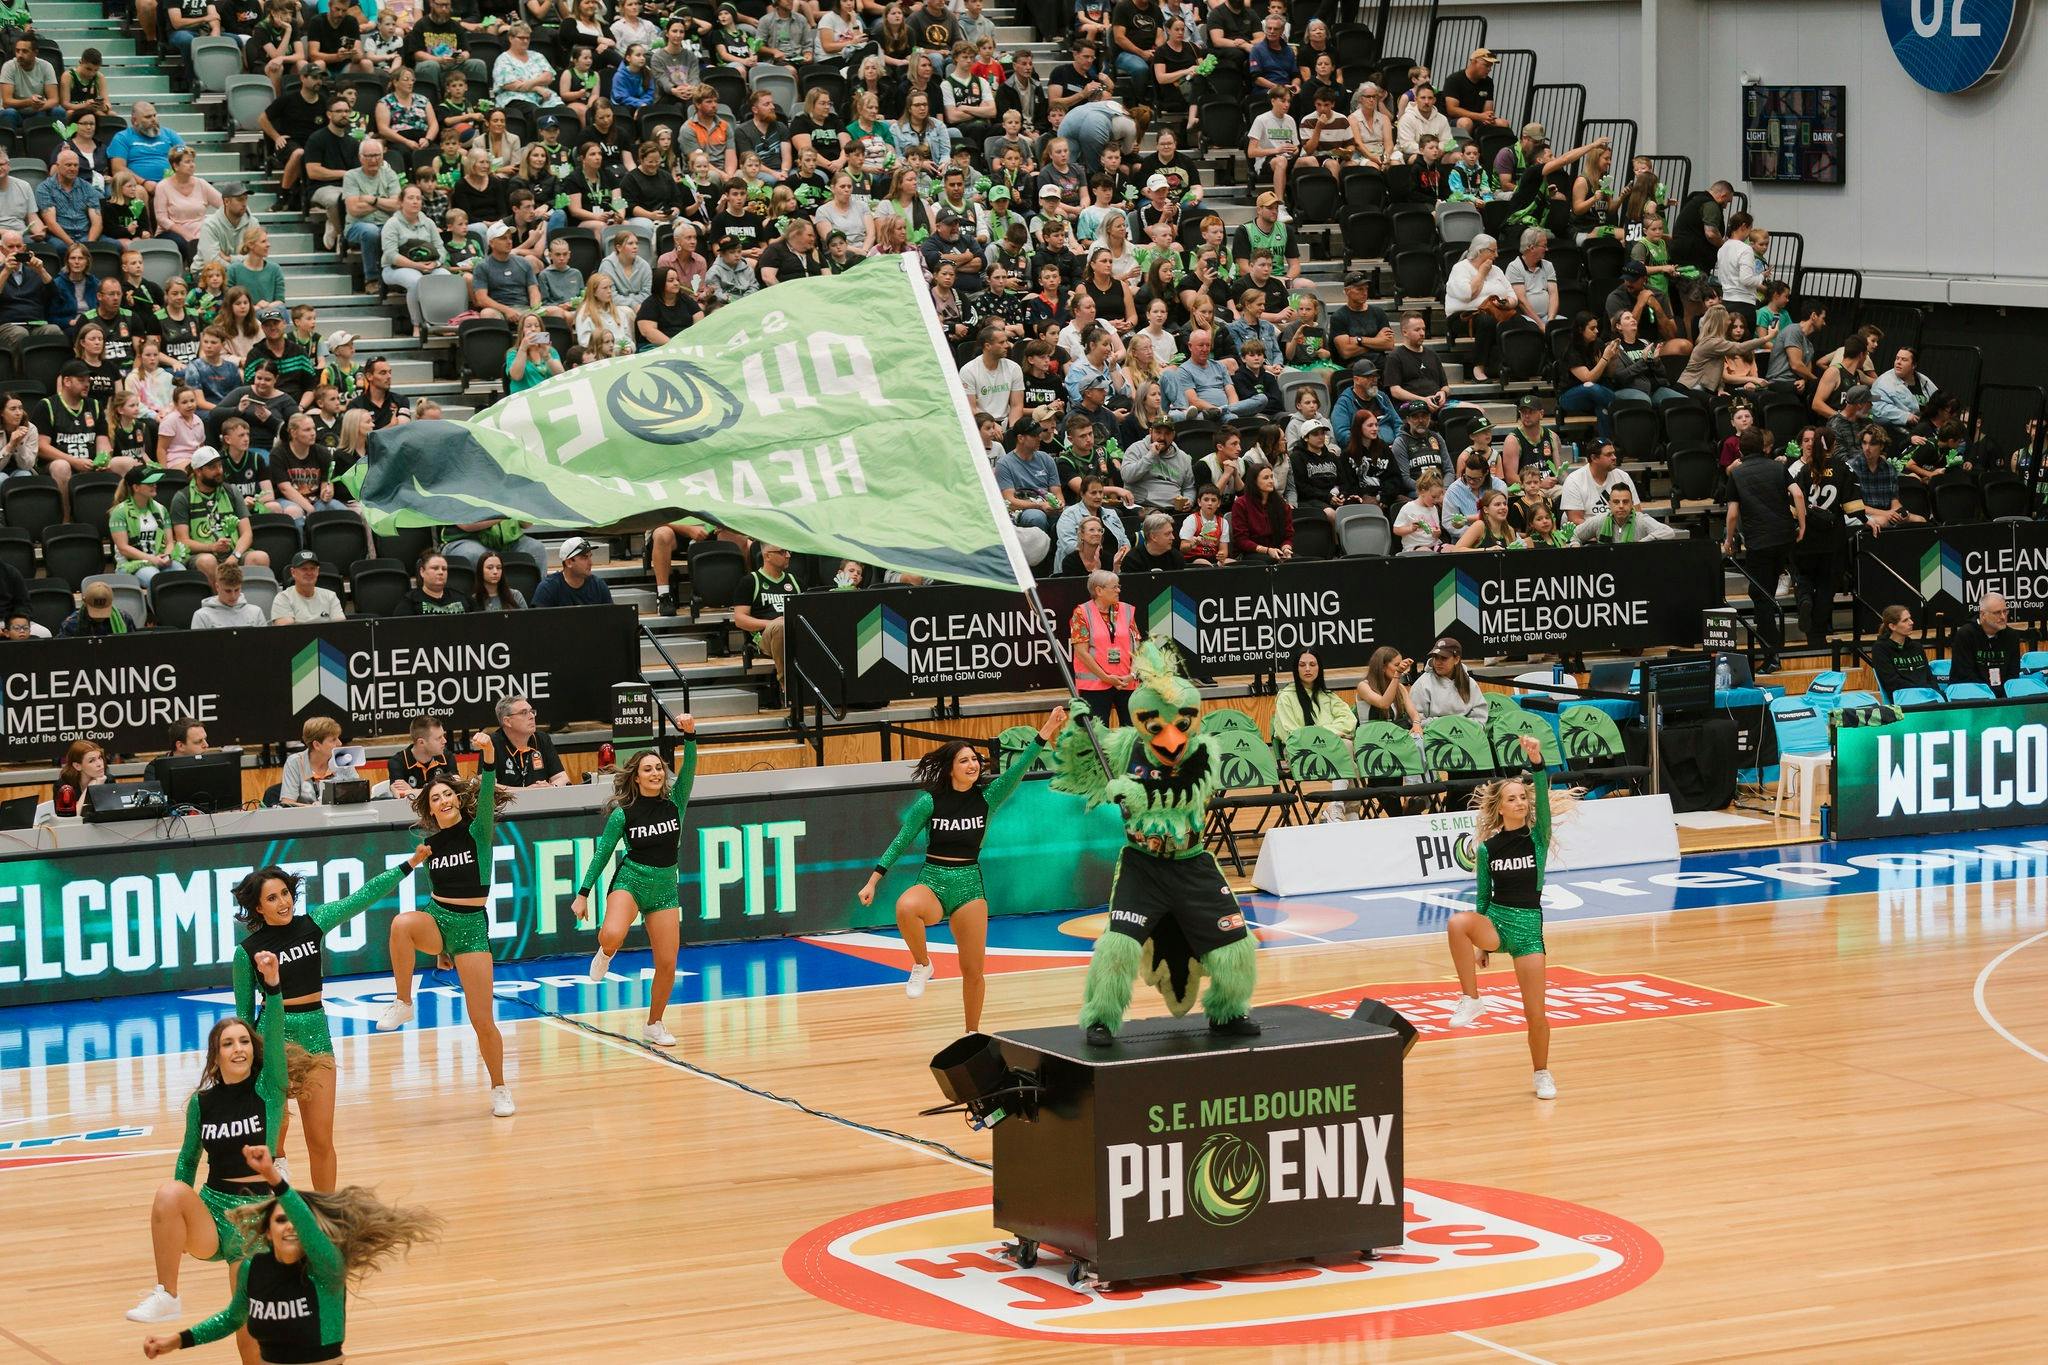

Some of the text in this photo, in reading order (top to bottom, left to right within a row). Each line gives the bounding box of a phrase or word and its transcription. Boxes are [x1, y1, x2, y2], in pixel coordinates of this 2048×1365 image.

[1746, 131, 1766, 141] LIGHT
[1812, 132, 1833, 142] DARK
[1965, 548, 2048, 575] CLEAN
[1481, 573, 1616, 605] CLEANING
[1966, 575, 2048, 604] MELBO
[1199, 590, 1340, 624] CLEANING
[2023, 600, 2044, 609] Group
[909, 608, 1057, 643] CLEANING
[1482, 600, 1649, 634] MELBOURNE
[1200, 618, 1375, 654] MELBOURNE
[1483, 631, 1567, 644] Part of the GDM Group
[1709, 630, 1723, 638] BANK
[349, 642, 511, 679] CLEANING
[911, 638, 1073, 674] MELBOURN
[1200, 650, 1290, 664] Part of the GDM Group
[5, 664, 177, 701] CLEANING
[912, 670, 1002, 684] Part of the GDM Group
[350, 672, 551, 711] MELBOURNE
[8, 694, 218, 734] MELBOURNE
[352, 706, 454, 722] Part of the GDM Group
[614, 717, 634, 725] SEATS
[622, 707, 638, 715] BANK
[9, 730, 115, 745] Part of the GDM Group
[1876, 724, 2048, 817] WELCO
[629, 818, 680, 838] TRADIE
[931, 815, 985, 832] TRADIE
[697, 820, 806, 920] PIT
[1112, 910, 1148, 927] TRADIE
[278, 941, 318, 965] ADIE
[1148, 1084, 1357, 1133] S.E. MELBOURNE
[202, 1115, 263, 1140] TRADIE
[249, 1297, 312, 1321] TRADIE
